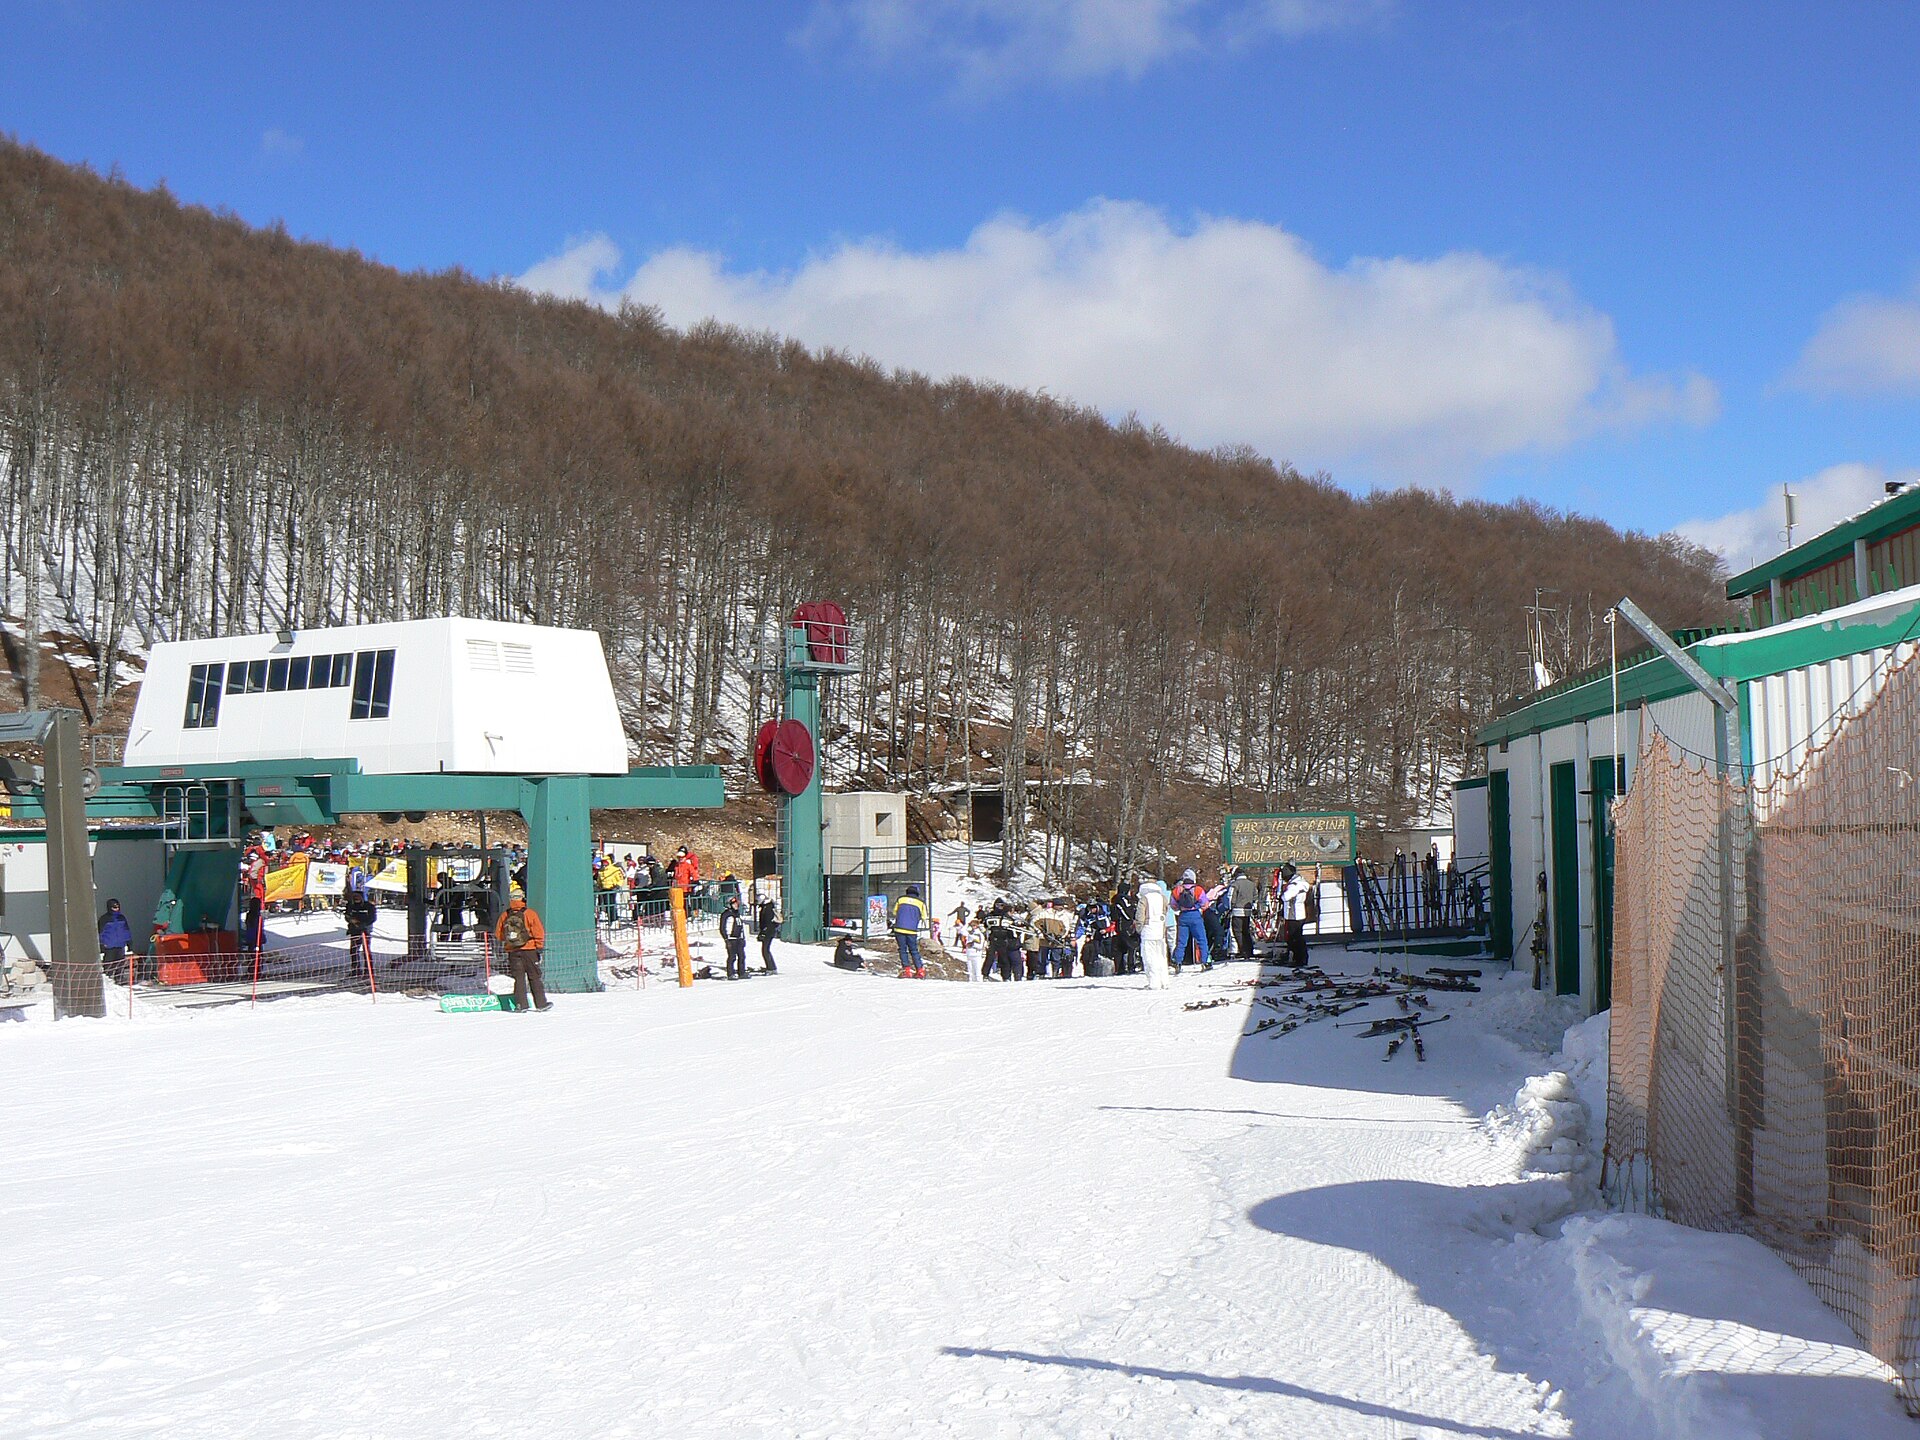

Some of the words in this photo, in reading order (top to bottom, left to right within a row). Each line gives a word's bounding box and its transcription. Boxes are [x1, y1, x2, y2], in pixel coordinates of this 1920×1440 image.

[1234, 821, 1258, 833] BAR
[1271, 819, 1346, 832] TELECABINA
[1253, 834, 1304, 847] PIZZERI
[1234, 850, 1274, 863] TAVOLA
